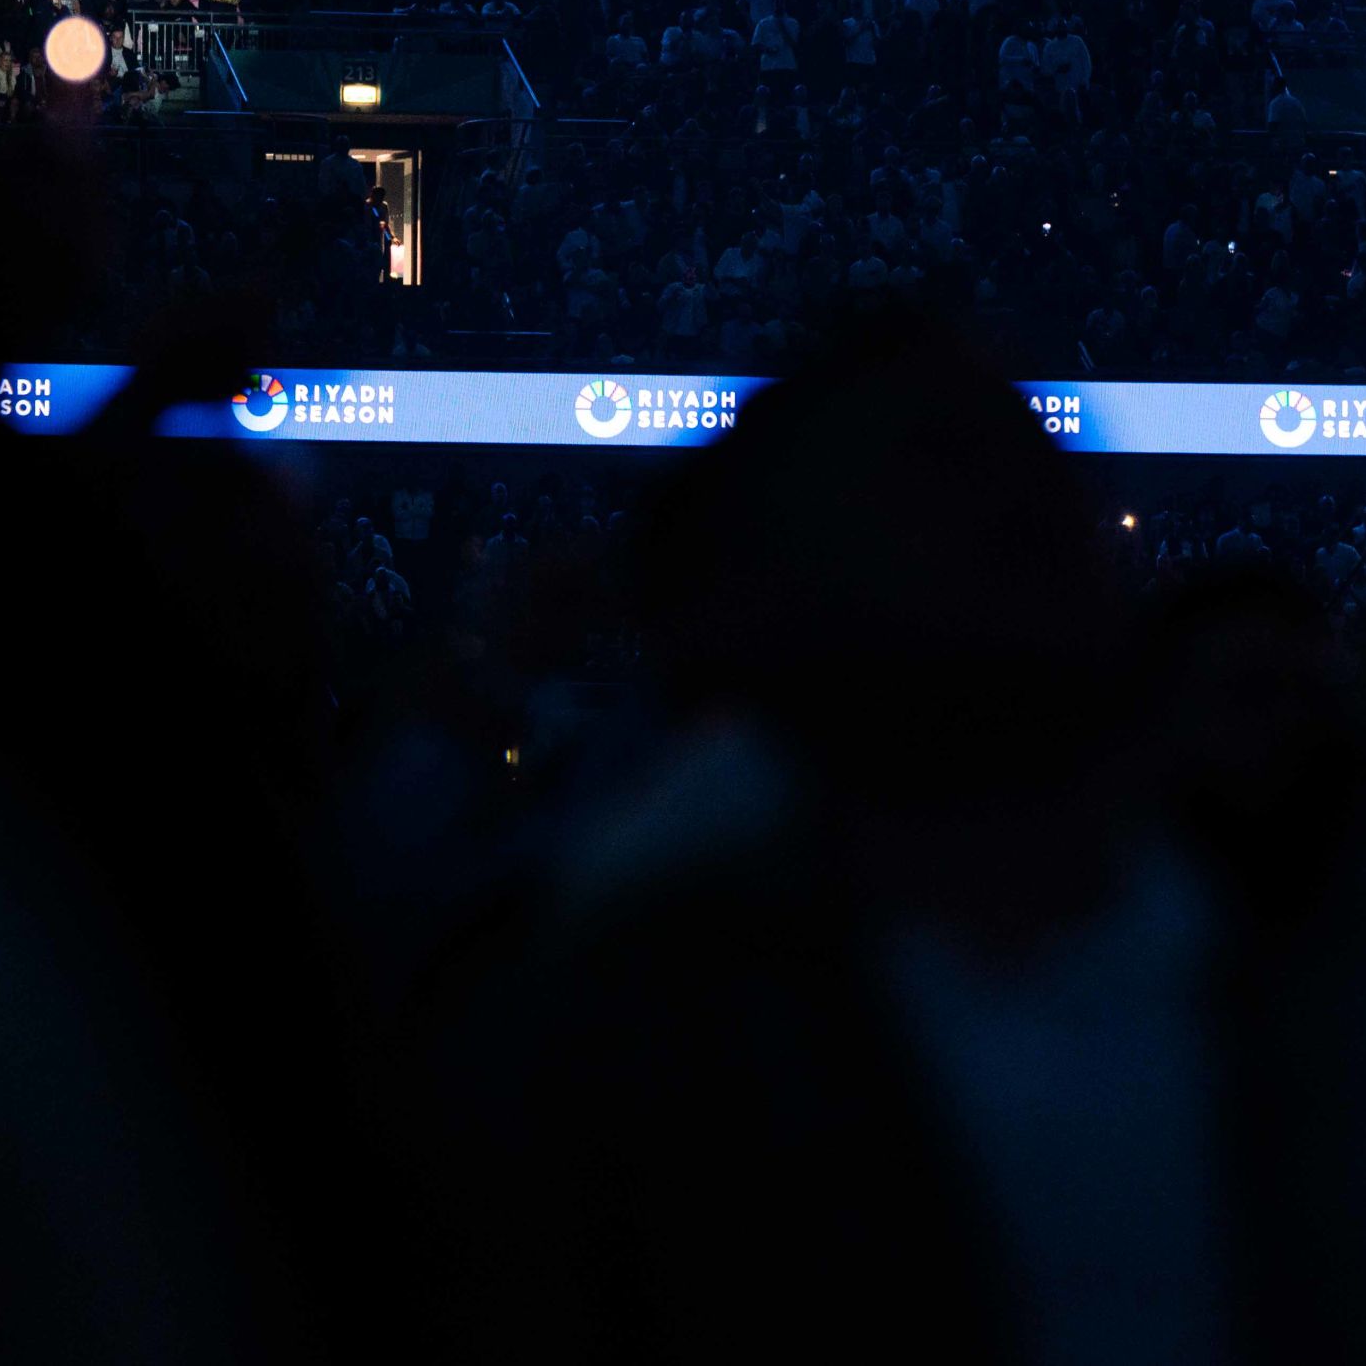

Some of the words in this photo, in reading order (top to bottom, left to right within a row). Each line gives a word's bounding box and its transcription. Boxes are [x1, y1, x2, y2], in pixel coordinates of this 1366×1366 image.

[294, 384, 394, 404] RIYADH
[638, 389, 736, 408] RIYADH
[0, 399, 51, 417] SON
[294, 405, 394, 424] SEASON
[1029, 396, 1081, 414] ADH
[637, 410, 735, 429] SEASON
